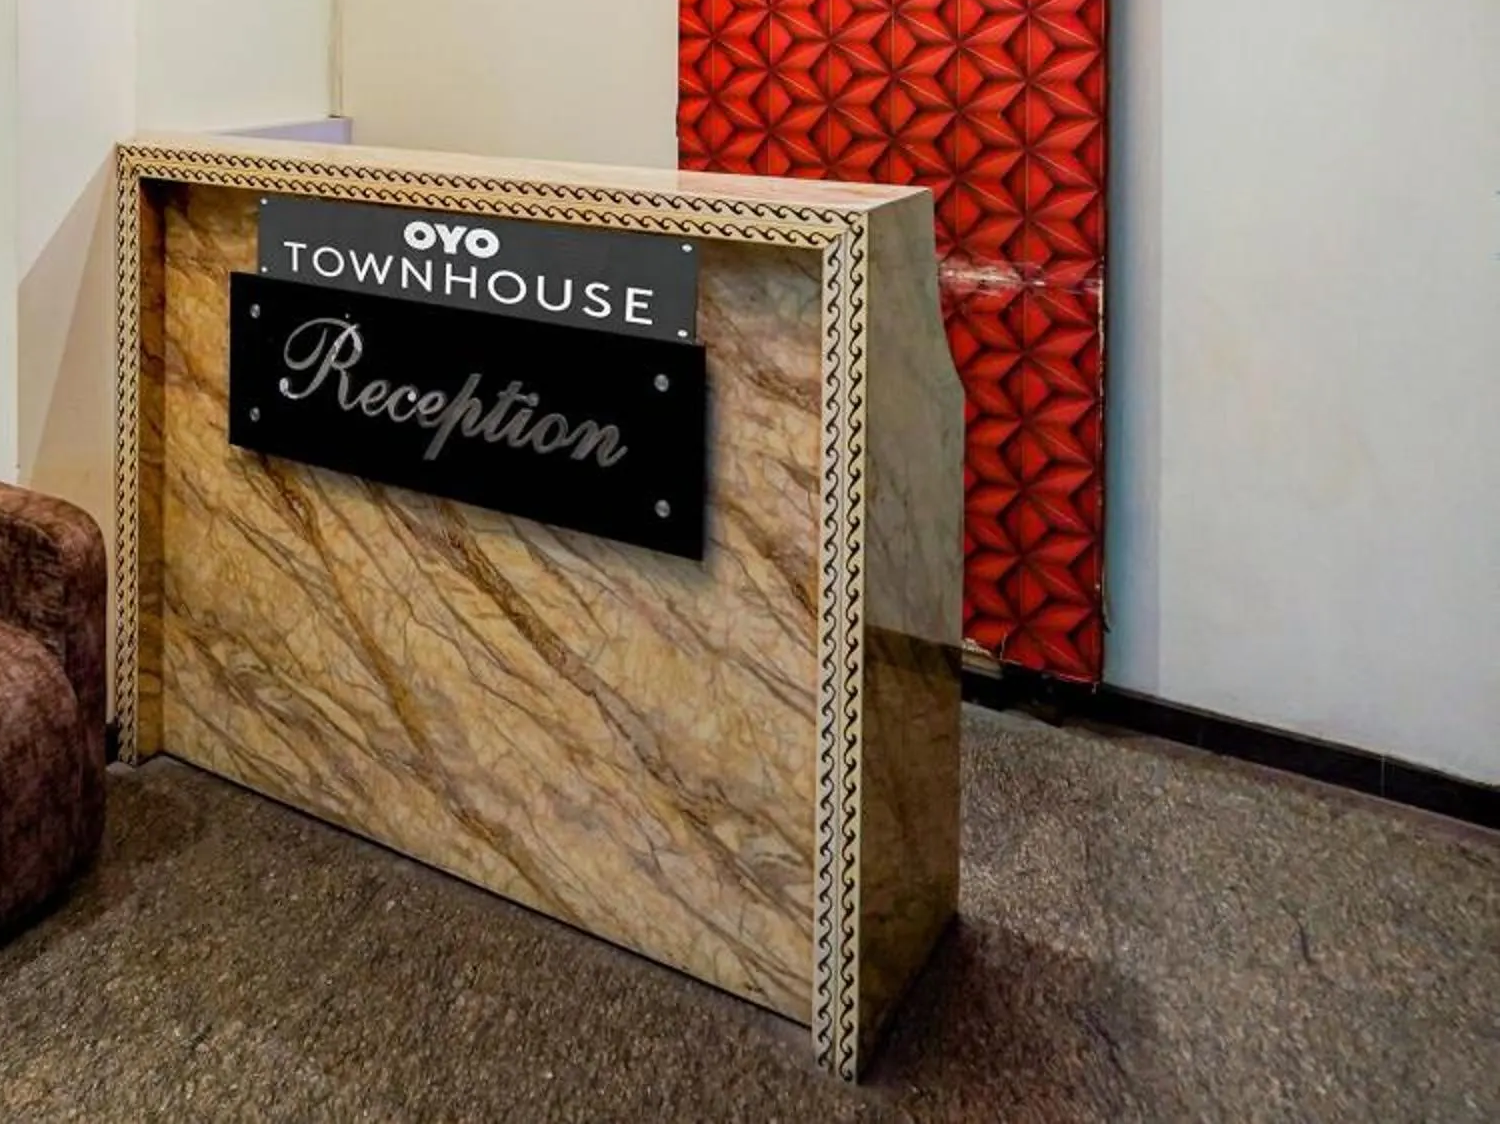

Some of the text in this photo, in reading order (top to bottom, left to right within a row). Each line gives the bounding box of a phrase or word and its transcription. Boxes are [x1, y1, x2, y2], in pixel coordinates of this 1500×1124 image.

[403, 220, 500, 259] OYO
[283, 241, 654, 325] TOWNHOUSE
[279, 315, 629, 468] Reception
